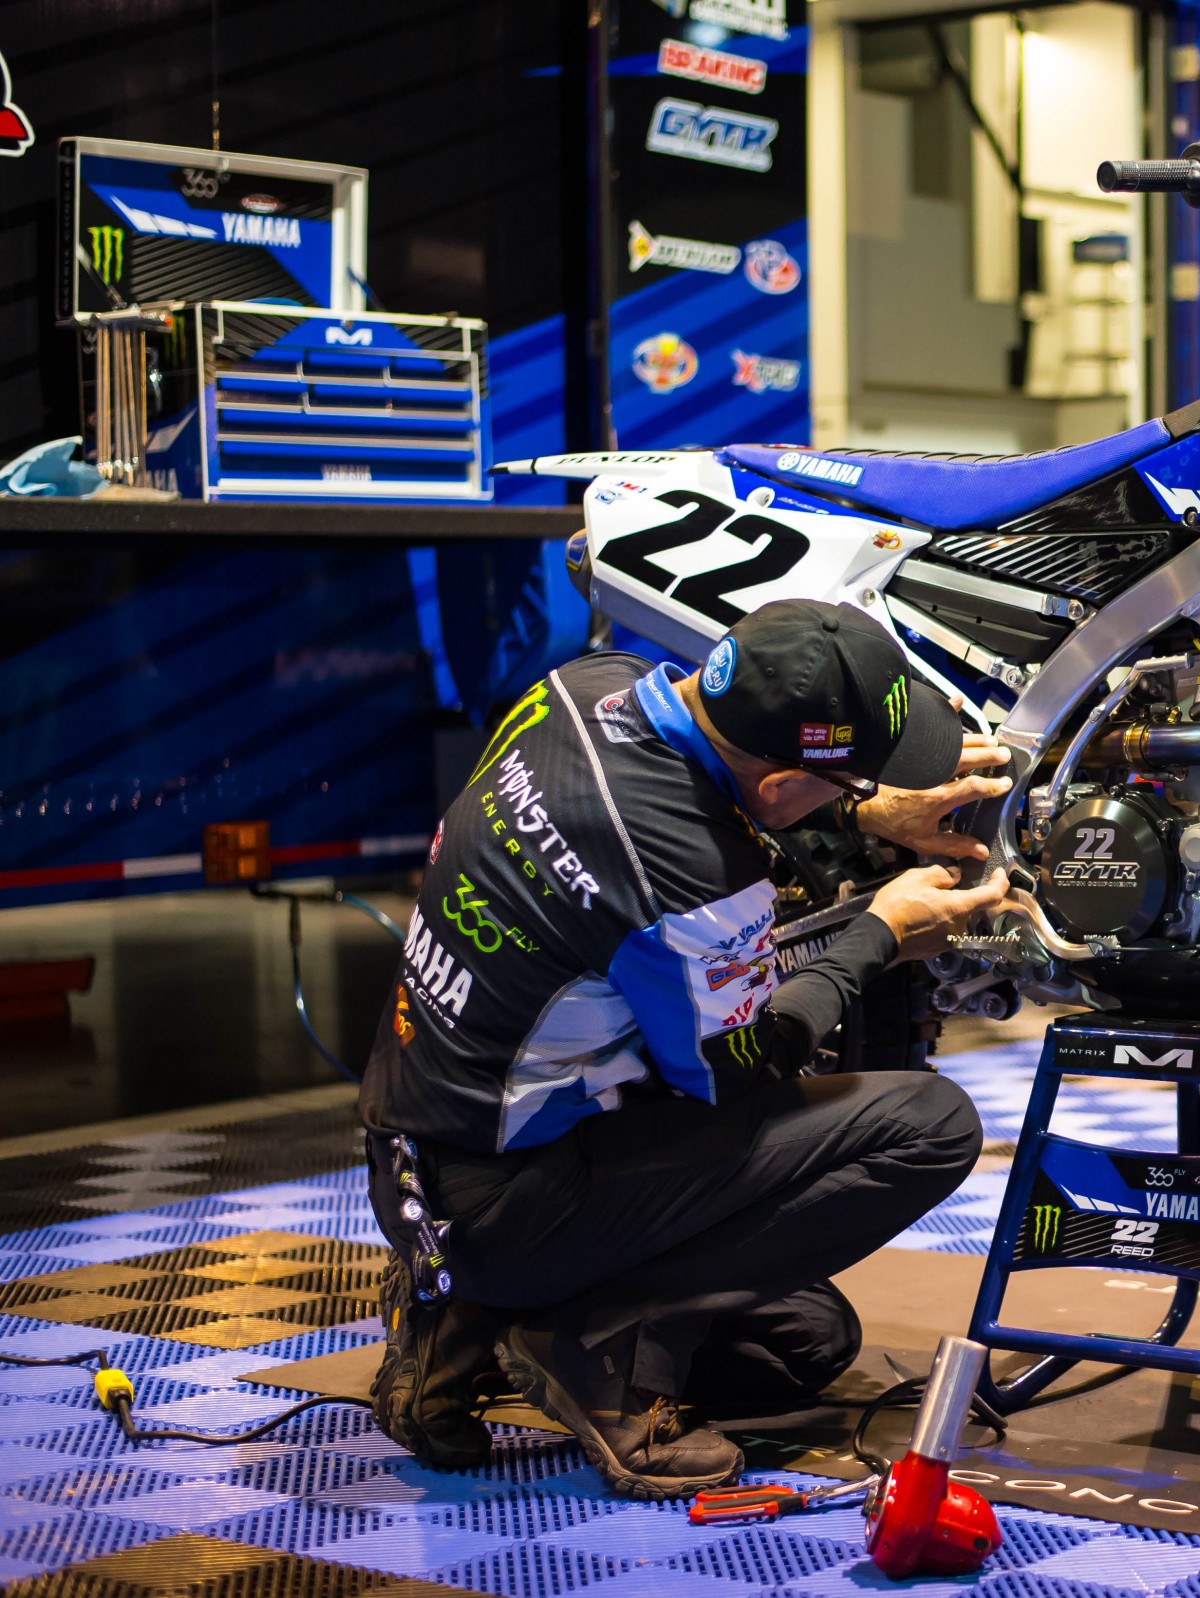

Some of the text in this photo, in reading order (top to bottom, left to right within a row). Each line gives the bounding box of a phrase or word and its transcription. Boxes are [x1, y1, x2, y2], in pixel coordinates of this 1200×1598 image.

[222, 213, 301, 248] YAMAHA
[796, 455, 863, 485] YAMAHA
[596, 489, 810, 629] 22
[711, 666, 722, 687] CRU
[803, 747, 849, 759] YAMALUBE
[498, 749, 600, 909] MONSTER
[481, 792, 555, 897] ENERGY
[1074, 828, 1115, 859] 22
[1053, 861, 1140, 879] GYTR
[444, 874, 541, 954] 360 FLY
[404, 903, 473, 1017] MAHA
[711, 965, 745, 983] GET
[1059, 1047, 1106, 1056] MATRIX
[1145, 1166, 1187, 1187] 360 FLY
[1110, 1219, 1160, 1244] 22
[1110, 1245, 1154, 1257] REED
